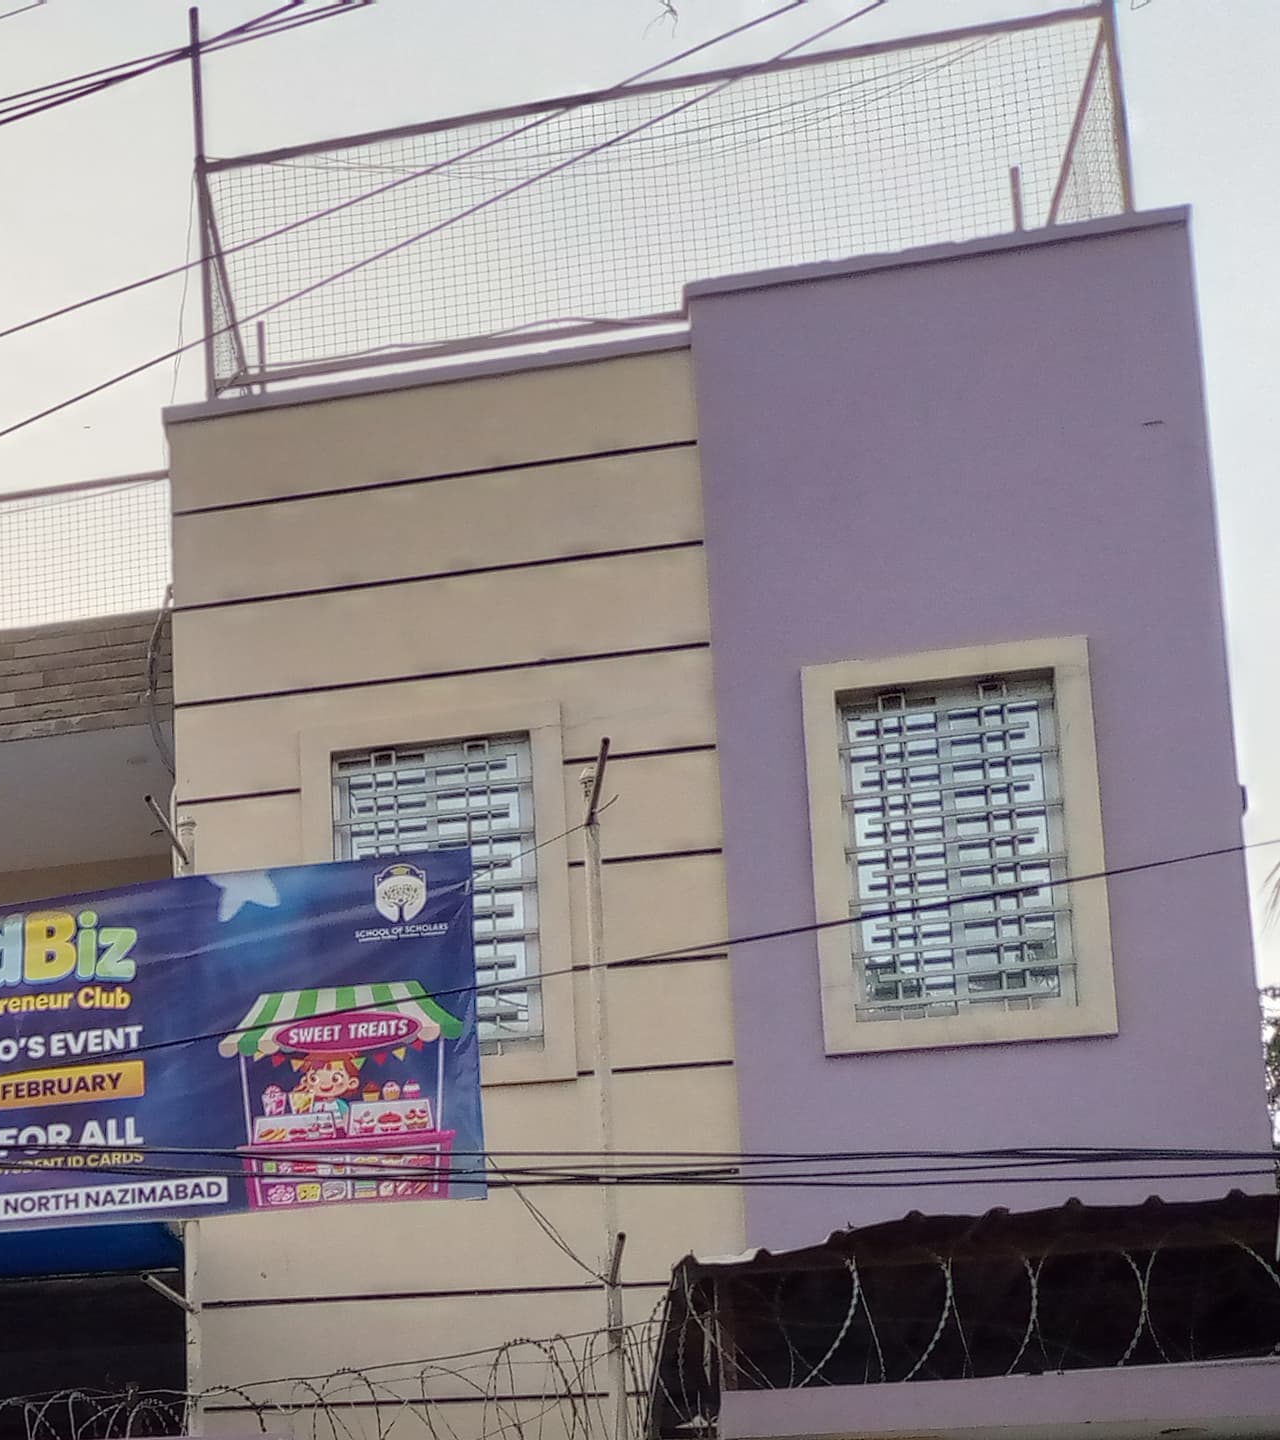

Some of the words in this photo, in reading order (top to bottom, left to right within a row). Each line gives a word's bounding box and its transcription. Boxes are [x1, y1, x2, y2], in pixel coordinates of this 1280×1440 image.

[77, 985, 131, 1009] Club
[50, 1025, 143, 1057] EVENT
[288, 1024, 342, 1044] SWEET
[348, 1020, 408, 1039] TREATS
[1, 1072, 123, 1101] FEBRUARY
[79, 1117, 144, 1147] ALL
[68, 1153, 83, 1168] ID
[85, 1151, 144, 1168] CARDS
[3, 1191, 79, 1216] NORTH
[85, 1181, 222, 1208] NAZIMABAD
